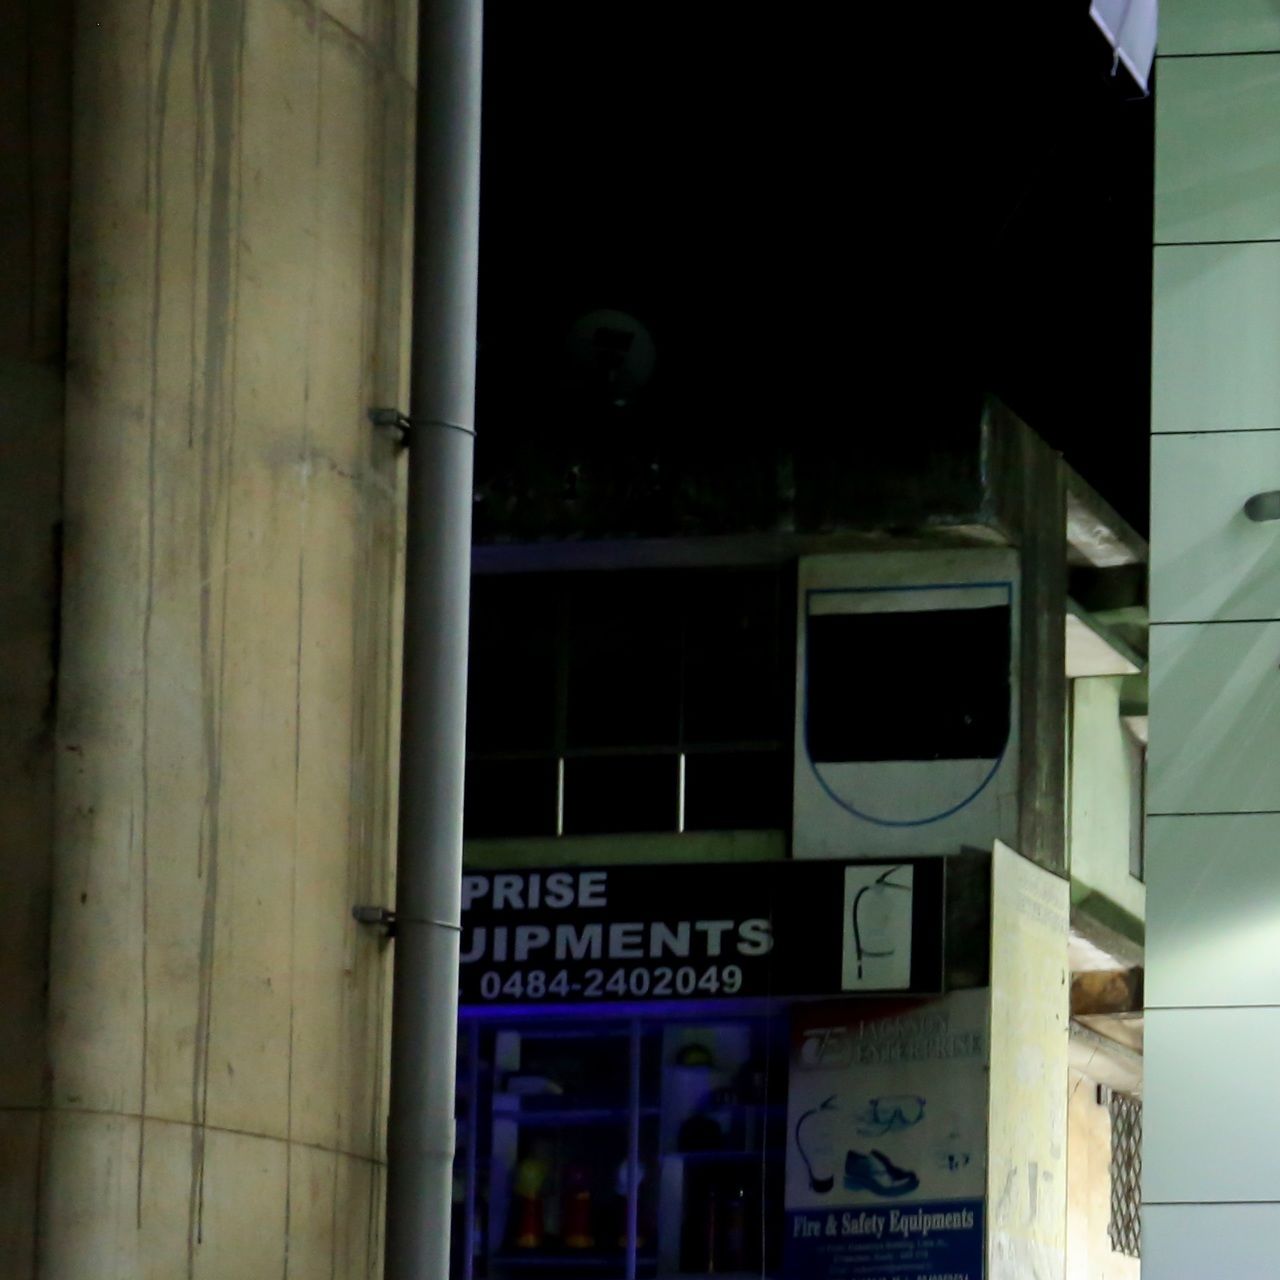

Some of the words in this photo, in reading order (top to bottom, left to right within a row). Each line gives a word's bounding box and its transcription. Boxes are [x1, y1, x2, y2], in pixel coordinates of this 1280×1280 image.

[461, 872, 608, 911] PRISE
[480, 964, 744, 999] 0484-2402049
[792, 1214, 821, 1238] Fire
[825, 1213, 838, 1236] &
[841, 1211, 885, 1240] Safety
[889, 1207, 975, 1239] Equipments
